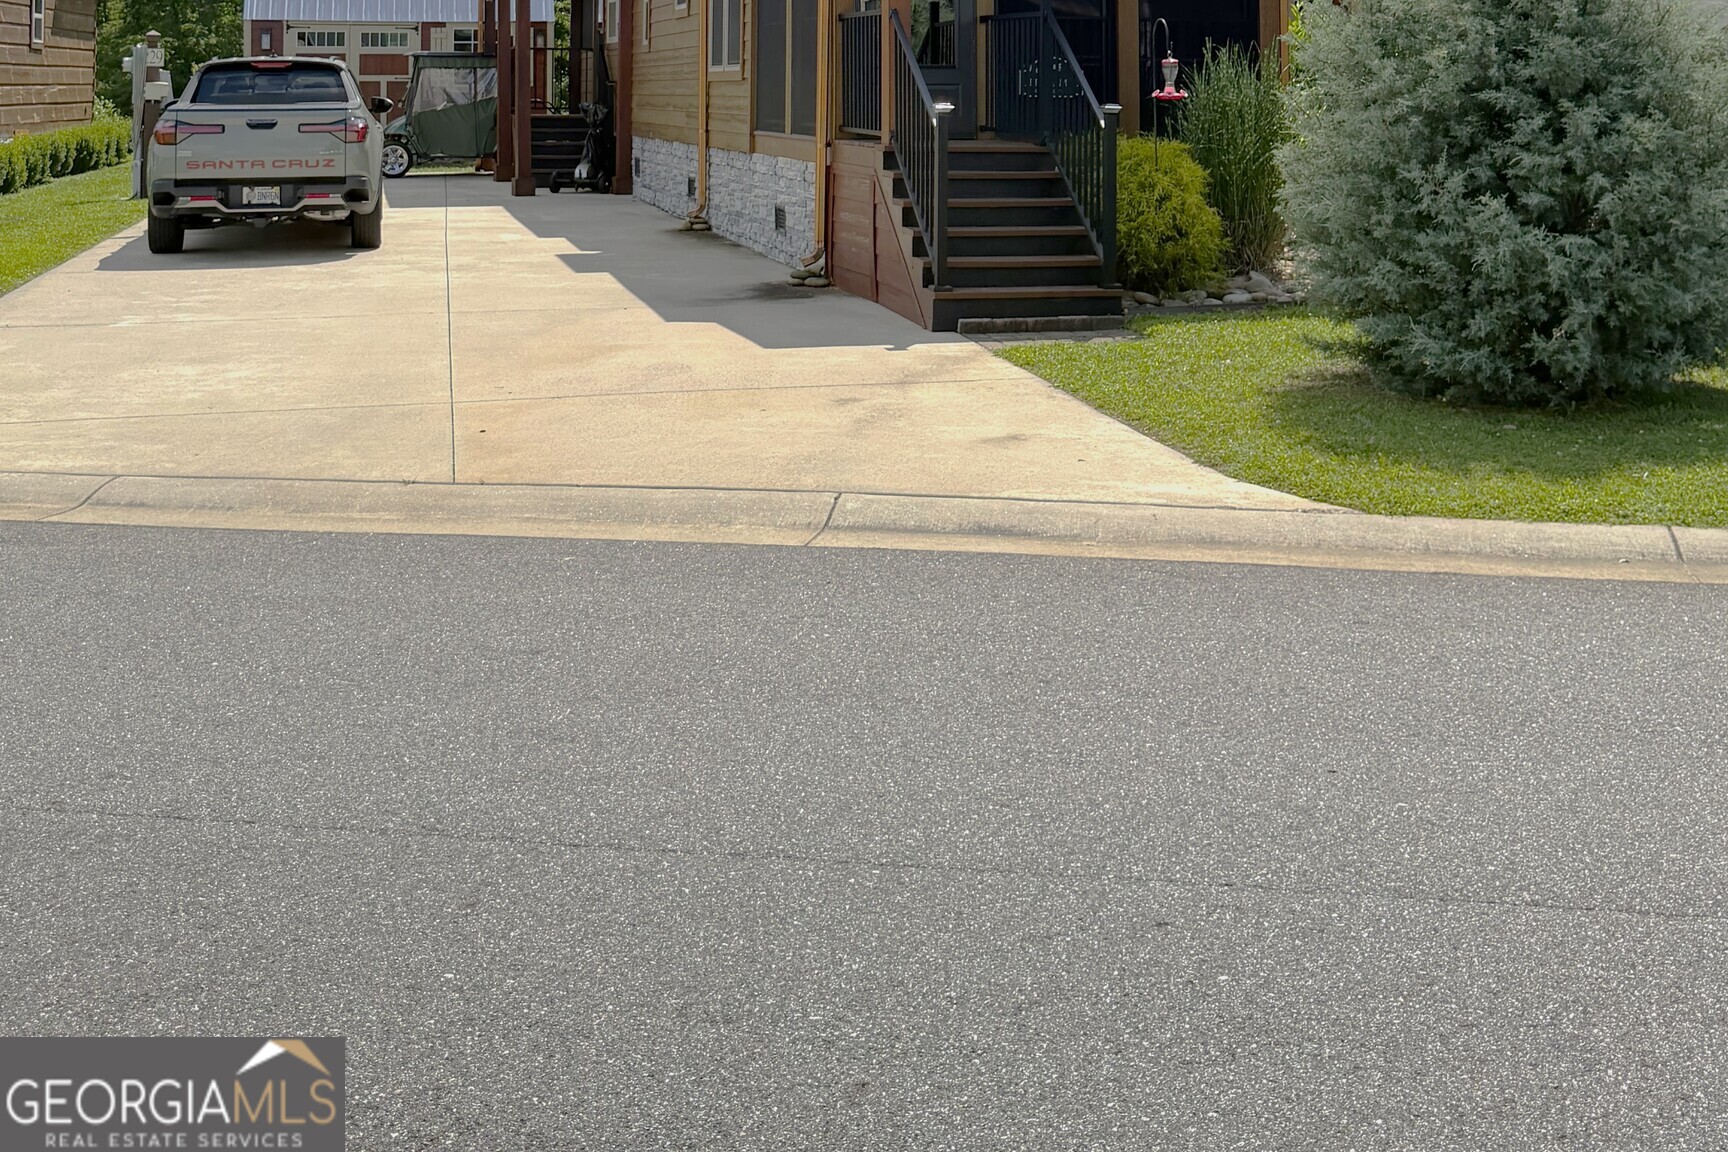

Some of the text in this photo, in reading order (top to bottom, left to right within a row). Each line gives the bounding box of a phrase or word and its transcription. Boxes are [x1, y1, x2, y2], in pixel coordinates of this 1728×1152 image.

[146, 50, 163, 65] 29
[186, 158, 335, 169] SANTA CRUZ
